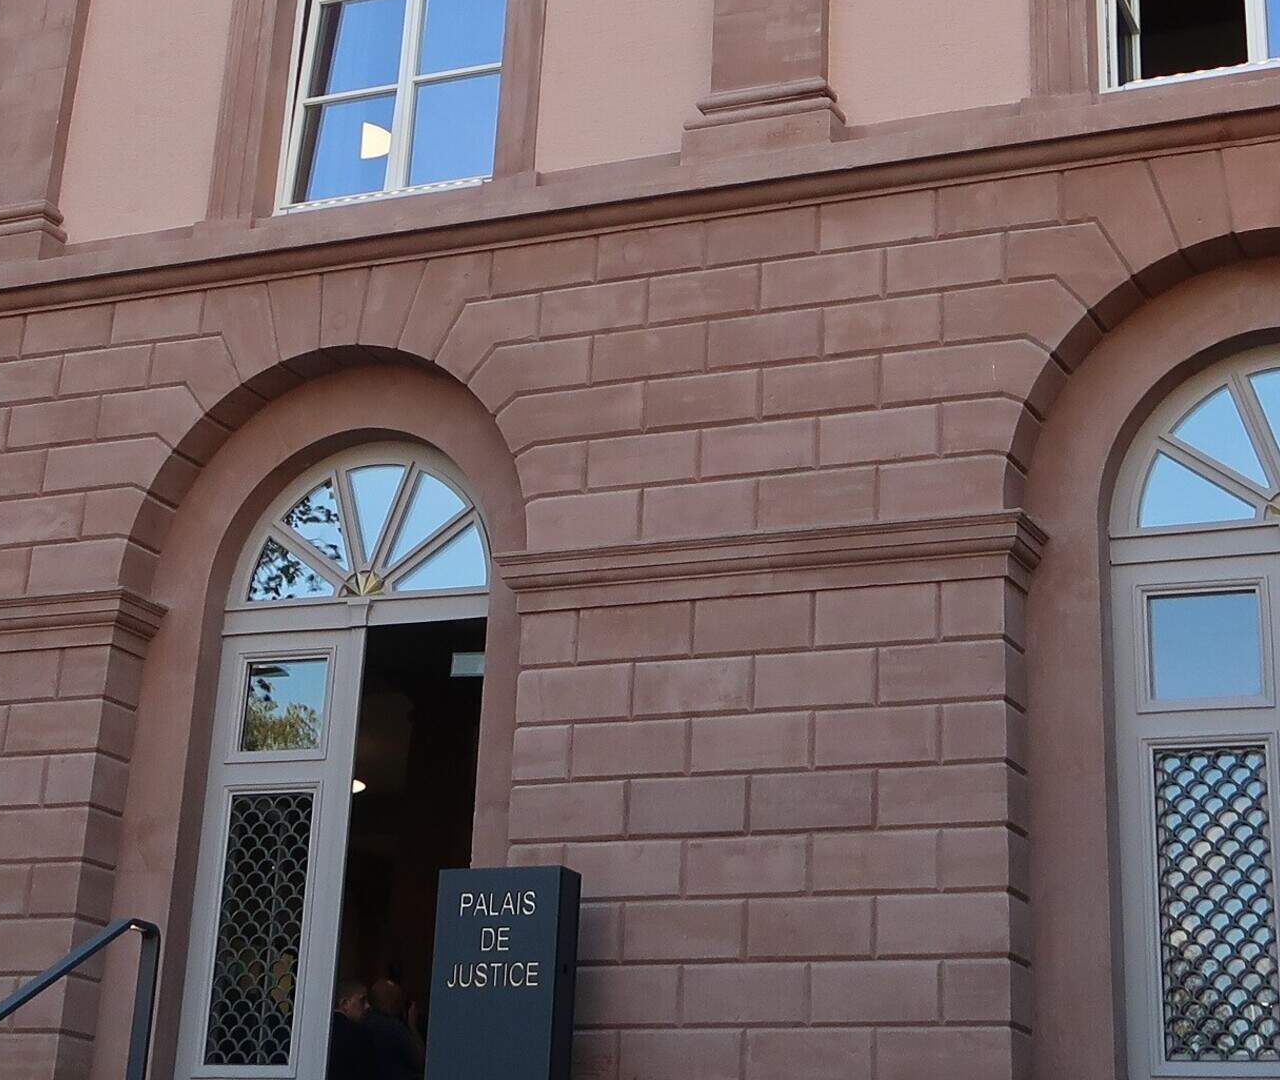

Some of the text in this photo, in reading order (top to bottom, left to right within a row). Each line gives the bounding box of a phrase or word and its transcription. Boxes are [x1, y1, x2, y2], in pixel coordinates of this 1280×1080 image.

[459, 891, 536, 917] PALAIS
[480, 927, 510, 951] DE
[447, 962, 539, 988] JUSTICE
